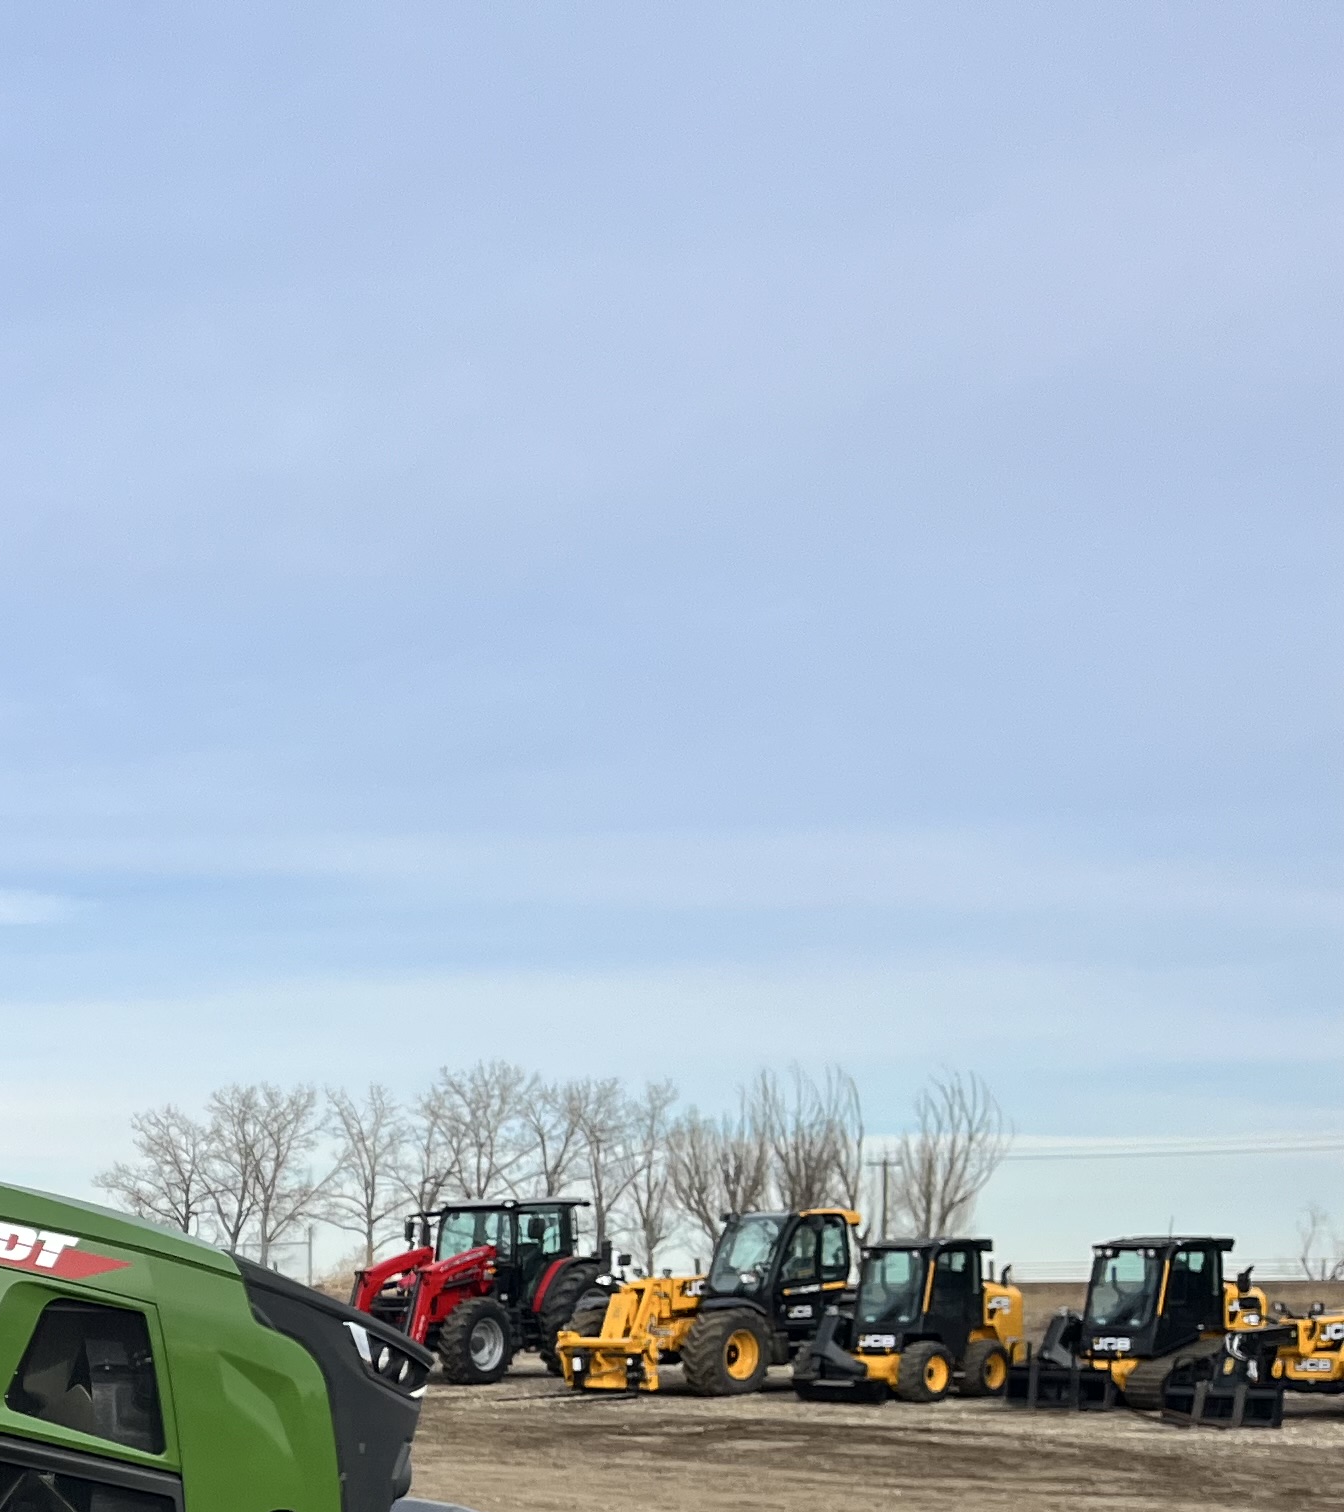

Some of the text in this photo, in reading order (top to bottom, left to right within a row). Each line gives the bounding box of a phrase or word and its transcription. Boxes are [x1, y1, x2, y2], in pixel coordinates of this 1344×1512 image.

[686, 1280, 705, 1297] JC
[787, 1304, 812, 1318] JCB
[859, 1334, 896, 1348] JCB
[1093, 1337, 1131, 1351] JCB
[1295, 1359, 1331, 1371] JCB
